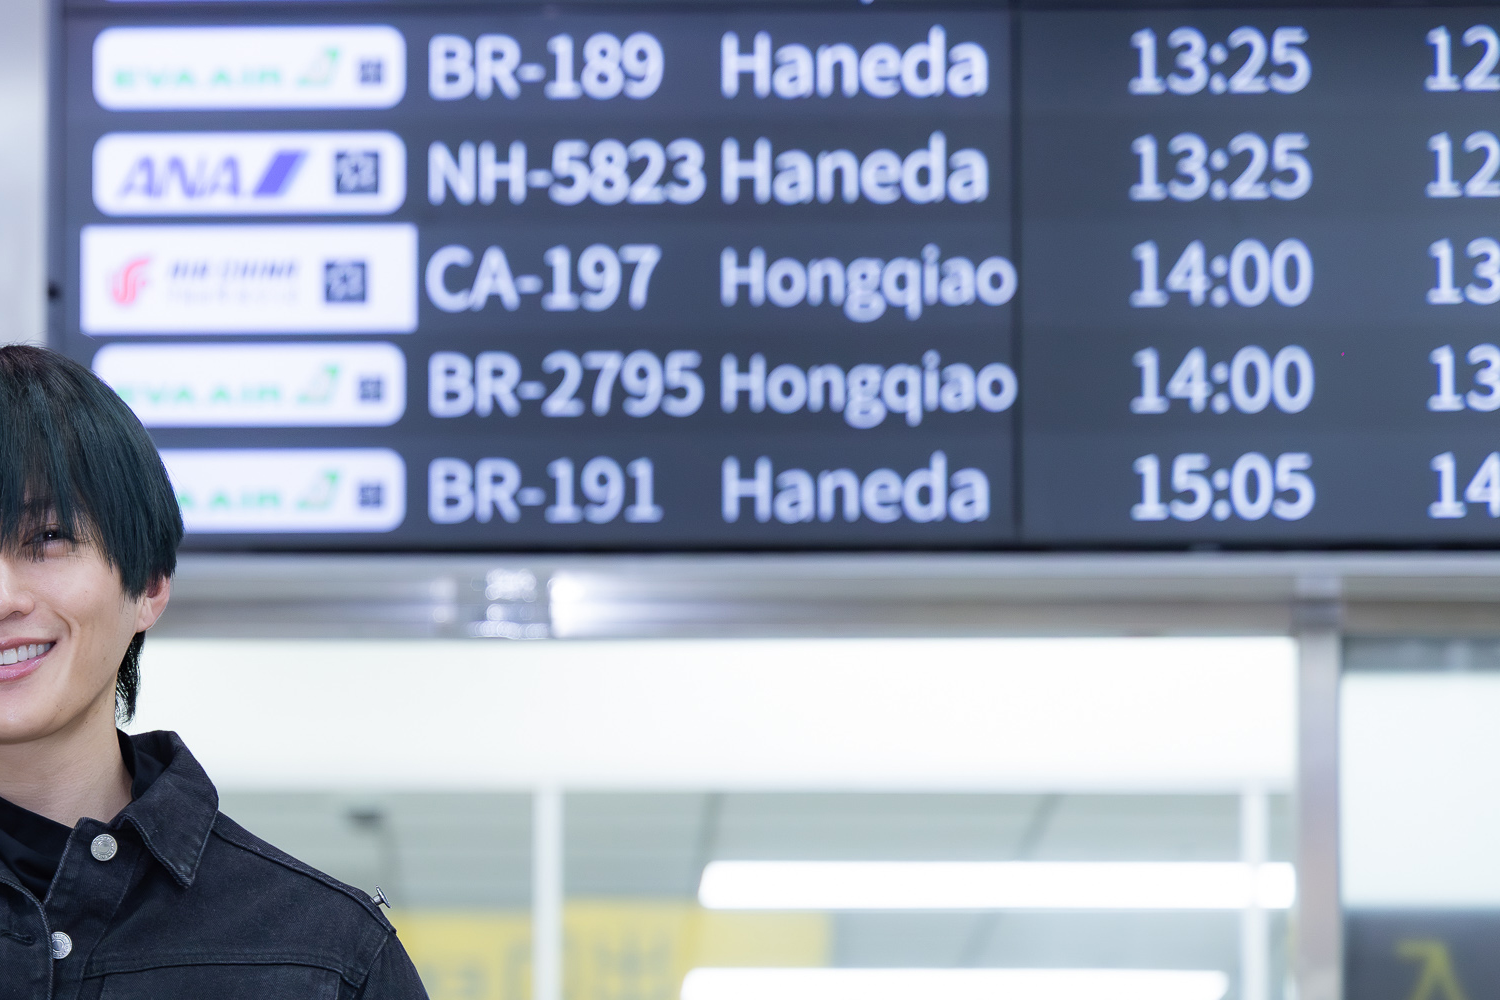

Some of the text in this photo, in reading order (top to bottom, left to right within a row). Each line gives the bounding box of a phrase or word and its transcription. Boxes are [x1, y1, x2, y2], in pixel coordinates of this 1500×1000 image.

[428, 33, 664, 100] BR-189
[722, 26, 988, 98] Haneda
[1131, 28, 1311, 94] 13:25
[116, 155, 244, 198] ANA
[428, 139, 706, 204] NH-5823
[722, 133, 988, 203] Haneda
[1132, 133, 1311, 200] 13:25
[426, 245, 660, 311] CA-197
[722, 244, 1017, 322] Hongqiao
[1133, 239, 1313, 306] 14:00
[429, 352, 704, 417] BR-2795
[722, 351, 1017, 428] Hongqiao
[1133, 346, 1314, 413] 14:00
[429, 458, 664, 523] BR-191
[722, 452, 989, 523] Haneda
[1133, 453, 1315, 520] 15:05
